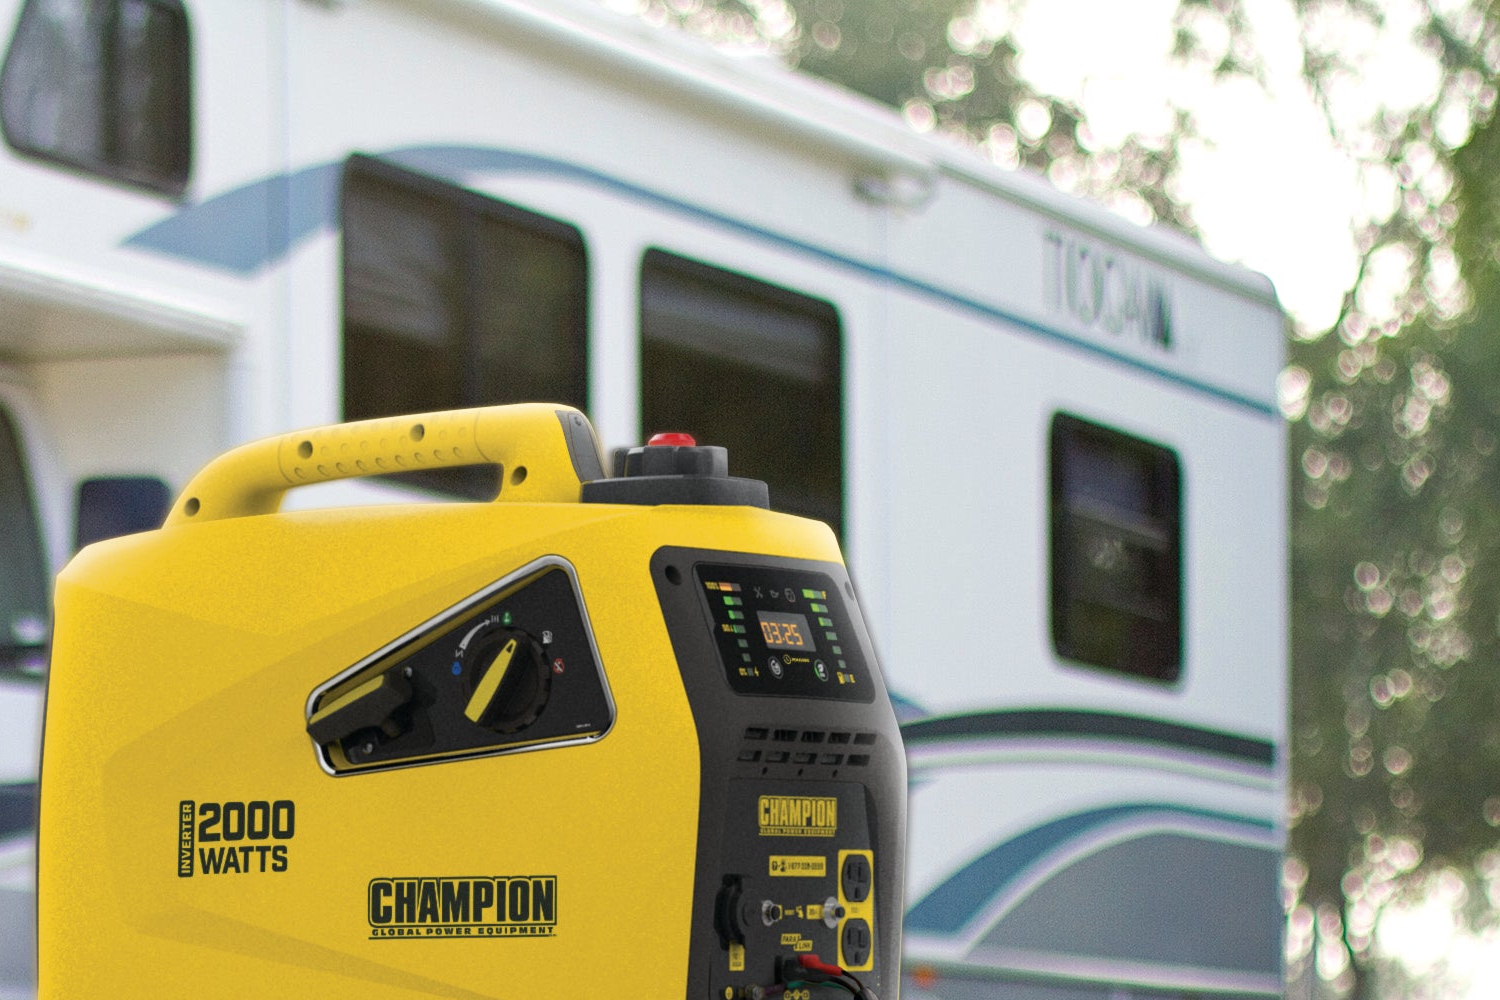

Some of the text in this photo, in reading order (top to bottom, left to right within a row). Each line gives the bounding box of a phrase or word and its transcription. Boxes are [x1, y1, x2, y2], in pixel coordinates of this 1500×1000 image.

[760, 621, 803, 646] 03:25
[198, 800, 295, 842] 2000
[760, 798, 836, 827] CHAMPION
[180, 803, 192, 874] INVERTER
[198, 845, 288, 875] WATTS
[371, 879, 554, 925] CHAMPION
[372, 926, 554, 937] GLOBAL POWER EQUIPMENT
